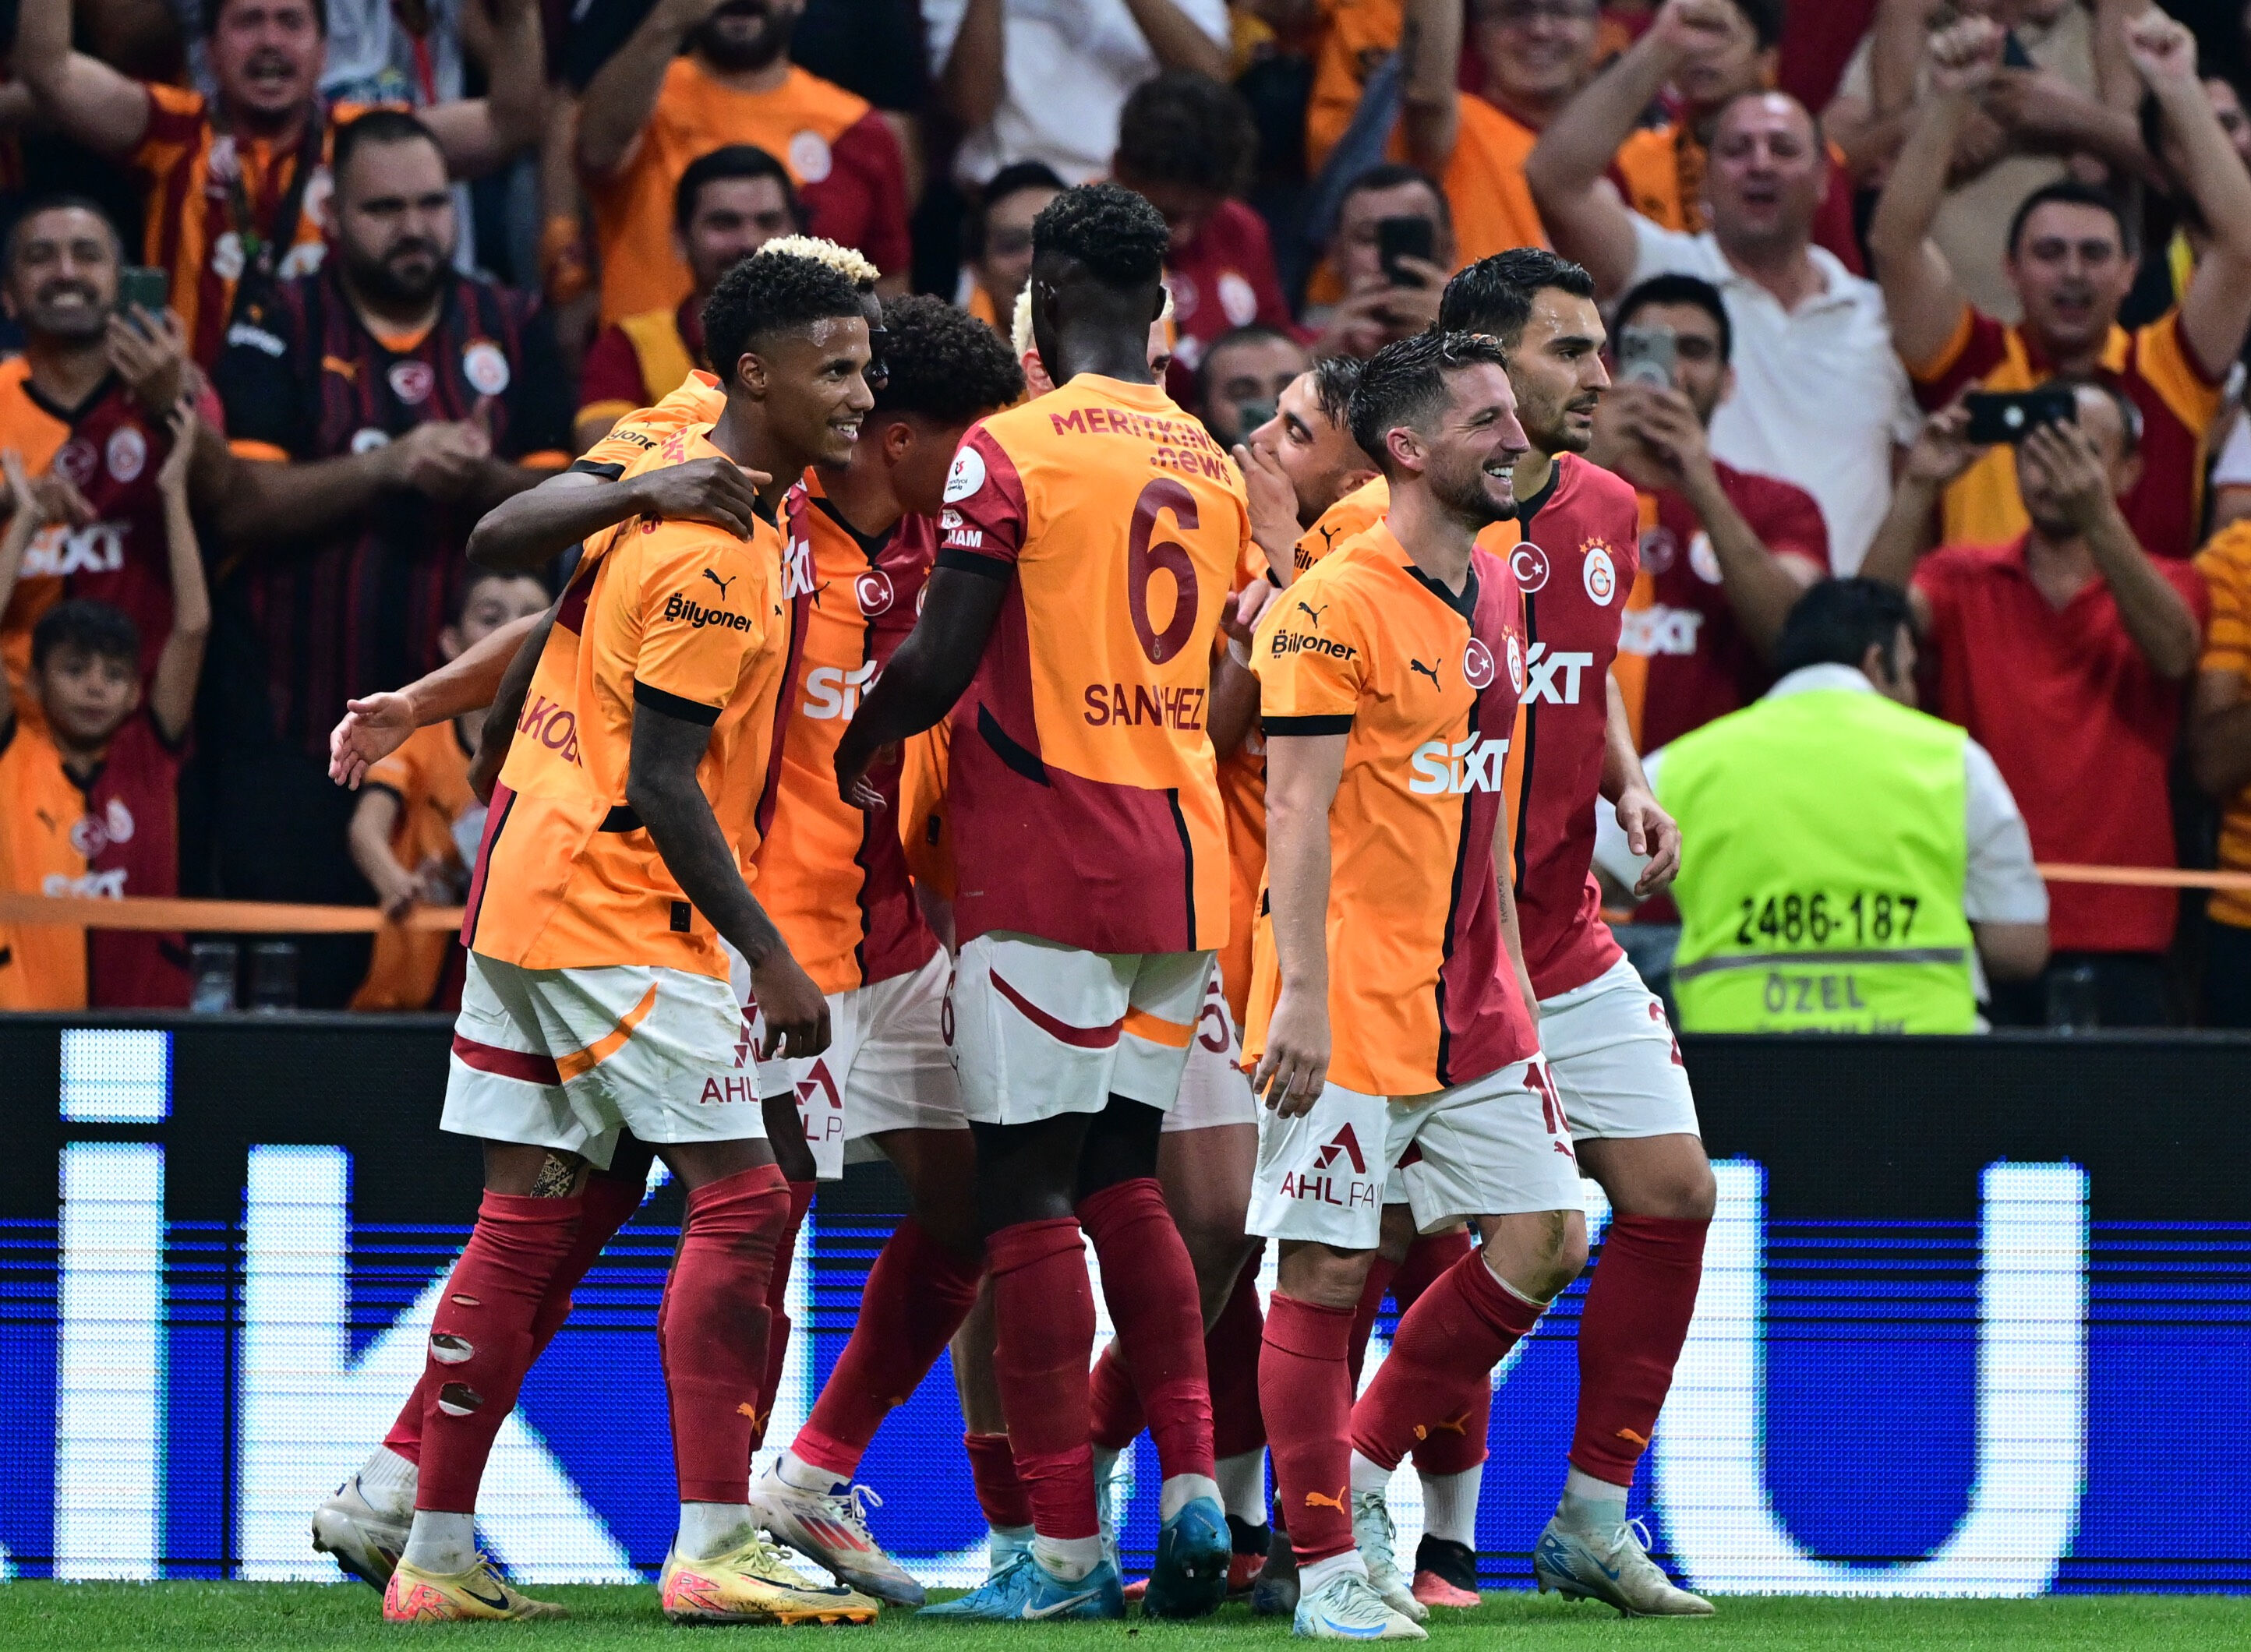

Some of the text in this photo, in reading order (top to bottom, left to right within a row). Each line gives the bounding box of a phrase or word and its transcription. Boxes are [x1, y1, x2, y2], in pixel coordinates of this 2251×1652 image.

[1150, 447, 1232, 486] .news
[1128, 478, 1199, 665] 6
[664, 593, 752, 633] Bilyoner
[1084, 683, 1205, 730] SANHEZ
[1735, 893, 1919, 945] 2486-187
[1763, 966, 1865, 1014] ÖZEL
